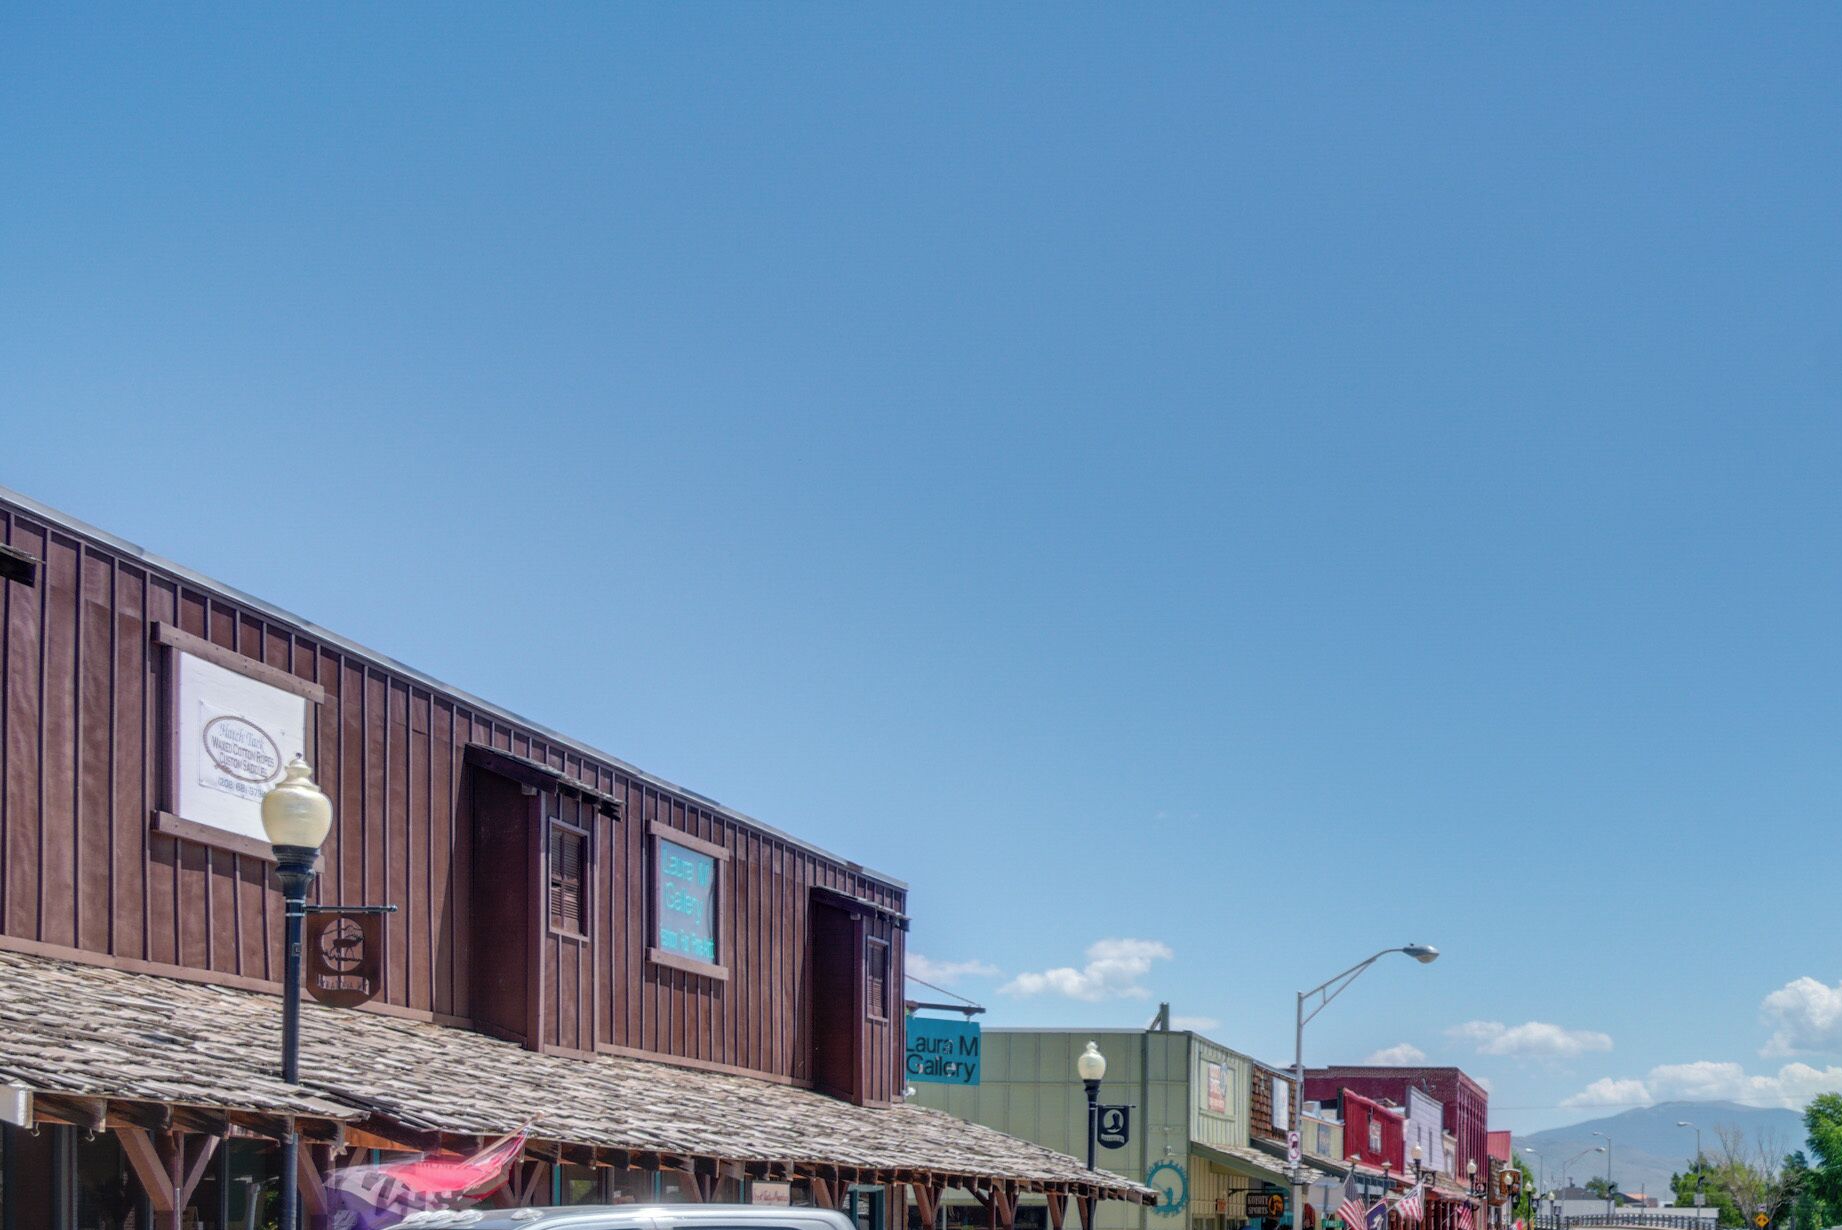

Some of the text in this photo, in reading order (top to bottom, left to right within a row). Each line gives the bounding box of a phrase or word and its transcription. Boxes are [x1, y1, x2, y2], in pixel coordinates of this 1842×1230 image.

[906, 1031, 979, 1057] Laura M
[906, 1054, 976, 1083] Gallery
